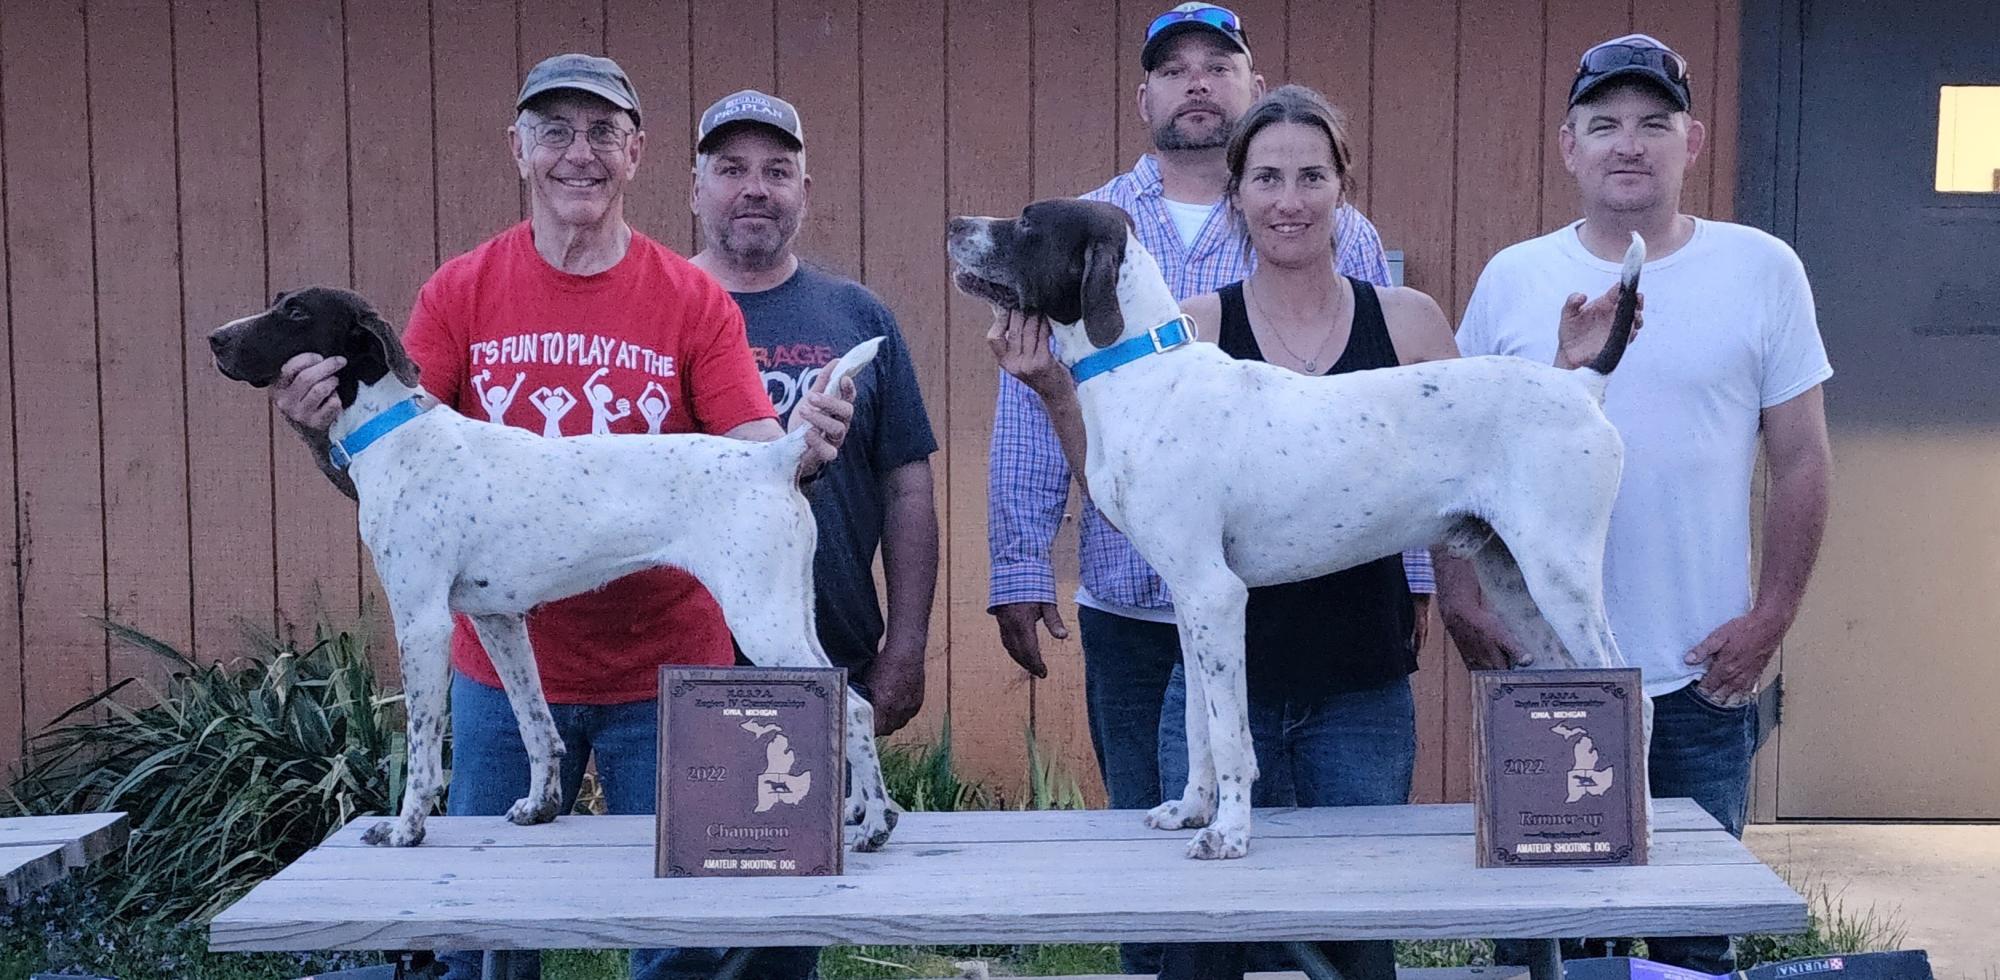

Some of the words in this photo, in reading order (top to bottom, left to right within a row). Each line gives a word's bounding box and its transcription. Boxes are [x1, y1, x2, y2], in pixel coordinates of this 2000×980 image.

[713, 105, 741, 124] PRO
[741, 104, 782, 119] PLAN
[470, 340, 499, 365] T'S
[501, 333, 538, 364] FUN
[540, 332, 564, 364] TO
[567, 333, 615, 365] PLAY
[615, 341, 640, 369] AT
[641, 348, 676, 377] THE
[745, 709, 778, 717] MICHIGAN
[1553, 711, 1587, 719] MICHIGAN
[687, 766, 727, 782] 2022
[1504, 759, 1545, 775] 2022
[1518, 811, 1604, 828] Runner-up
[706, 823, 790, 841] Champion
[1516, 843, 1552, 853] AMATEUR
[1554, 842, 1591, 853] SHOOTING
[1594, 842, 1611, 852] DOG
[703, 859, 738, 869] AMATEUR
[740, 859, 777, 870] SHOOTING
[780, 859, 796, 870] DOG
[1779, 960, 1829, 975] PURINA
